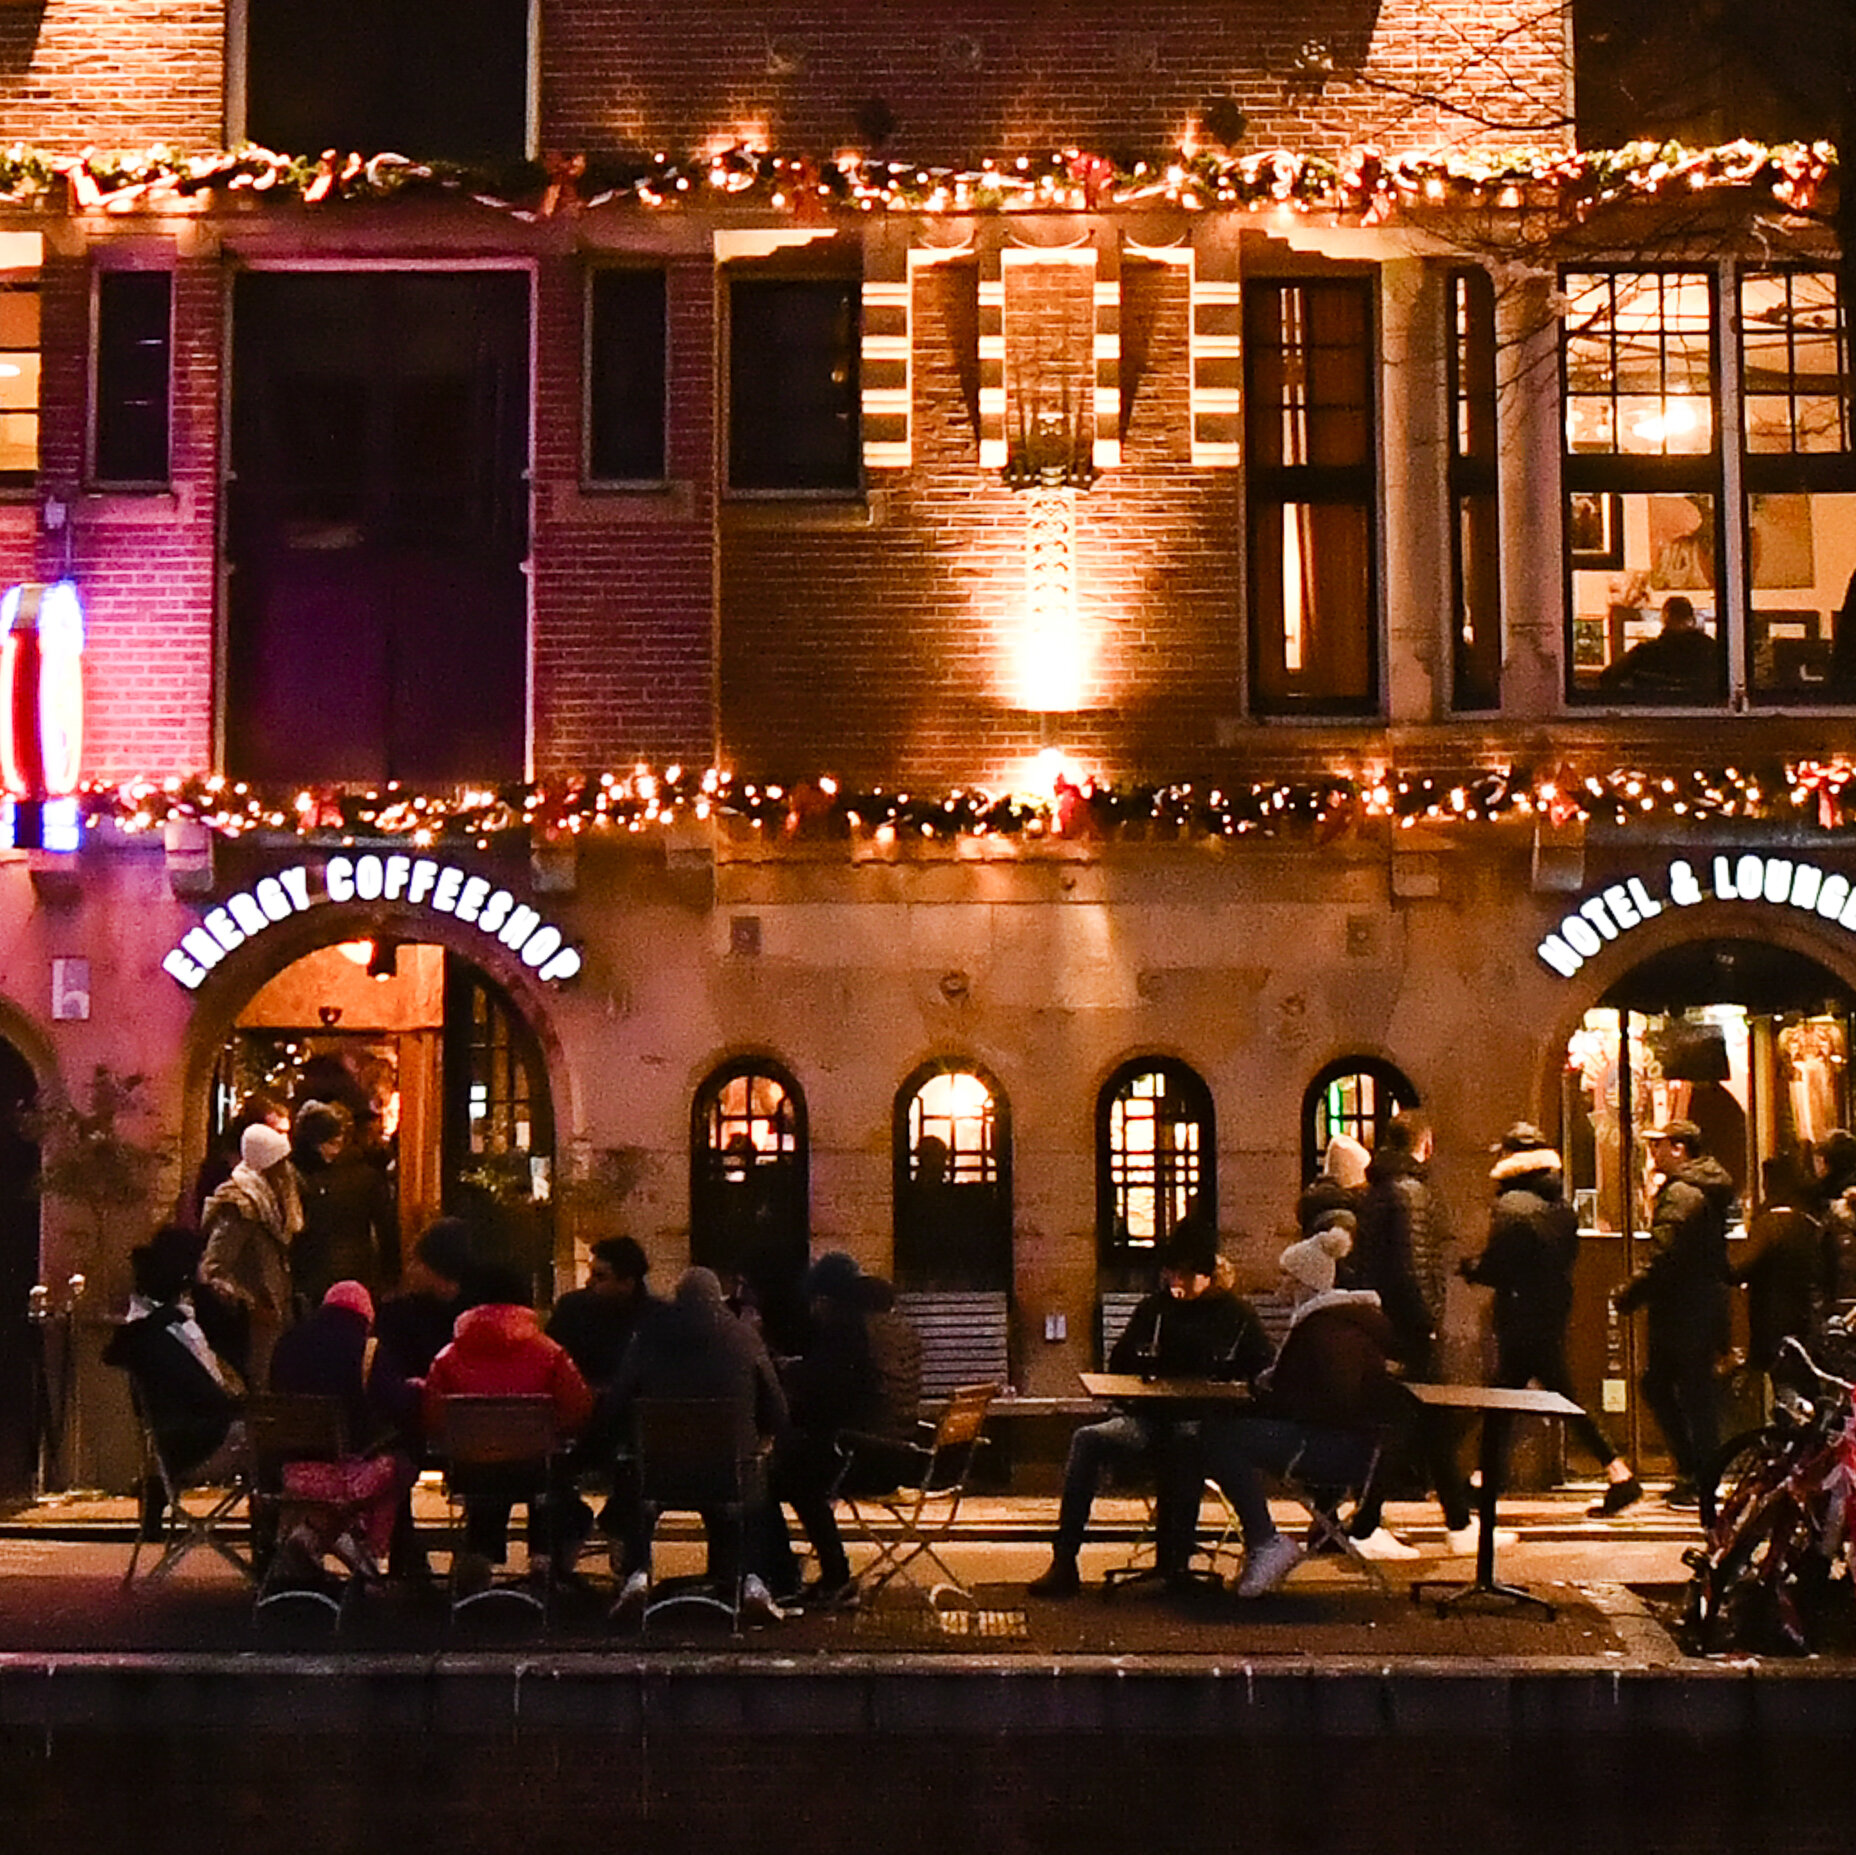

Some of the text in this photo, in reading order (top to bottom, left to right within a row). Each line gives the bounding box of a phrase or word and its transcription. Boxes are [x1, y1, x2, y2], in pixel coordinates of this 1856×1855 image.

[162, 854, 582, 990] ENERGY COFFEESHOP
[1537, 876, 1663, 978] HOTEL
[1669, 859, 1703, 907] &
